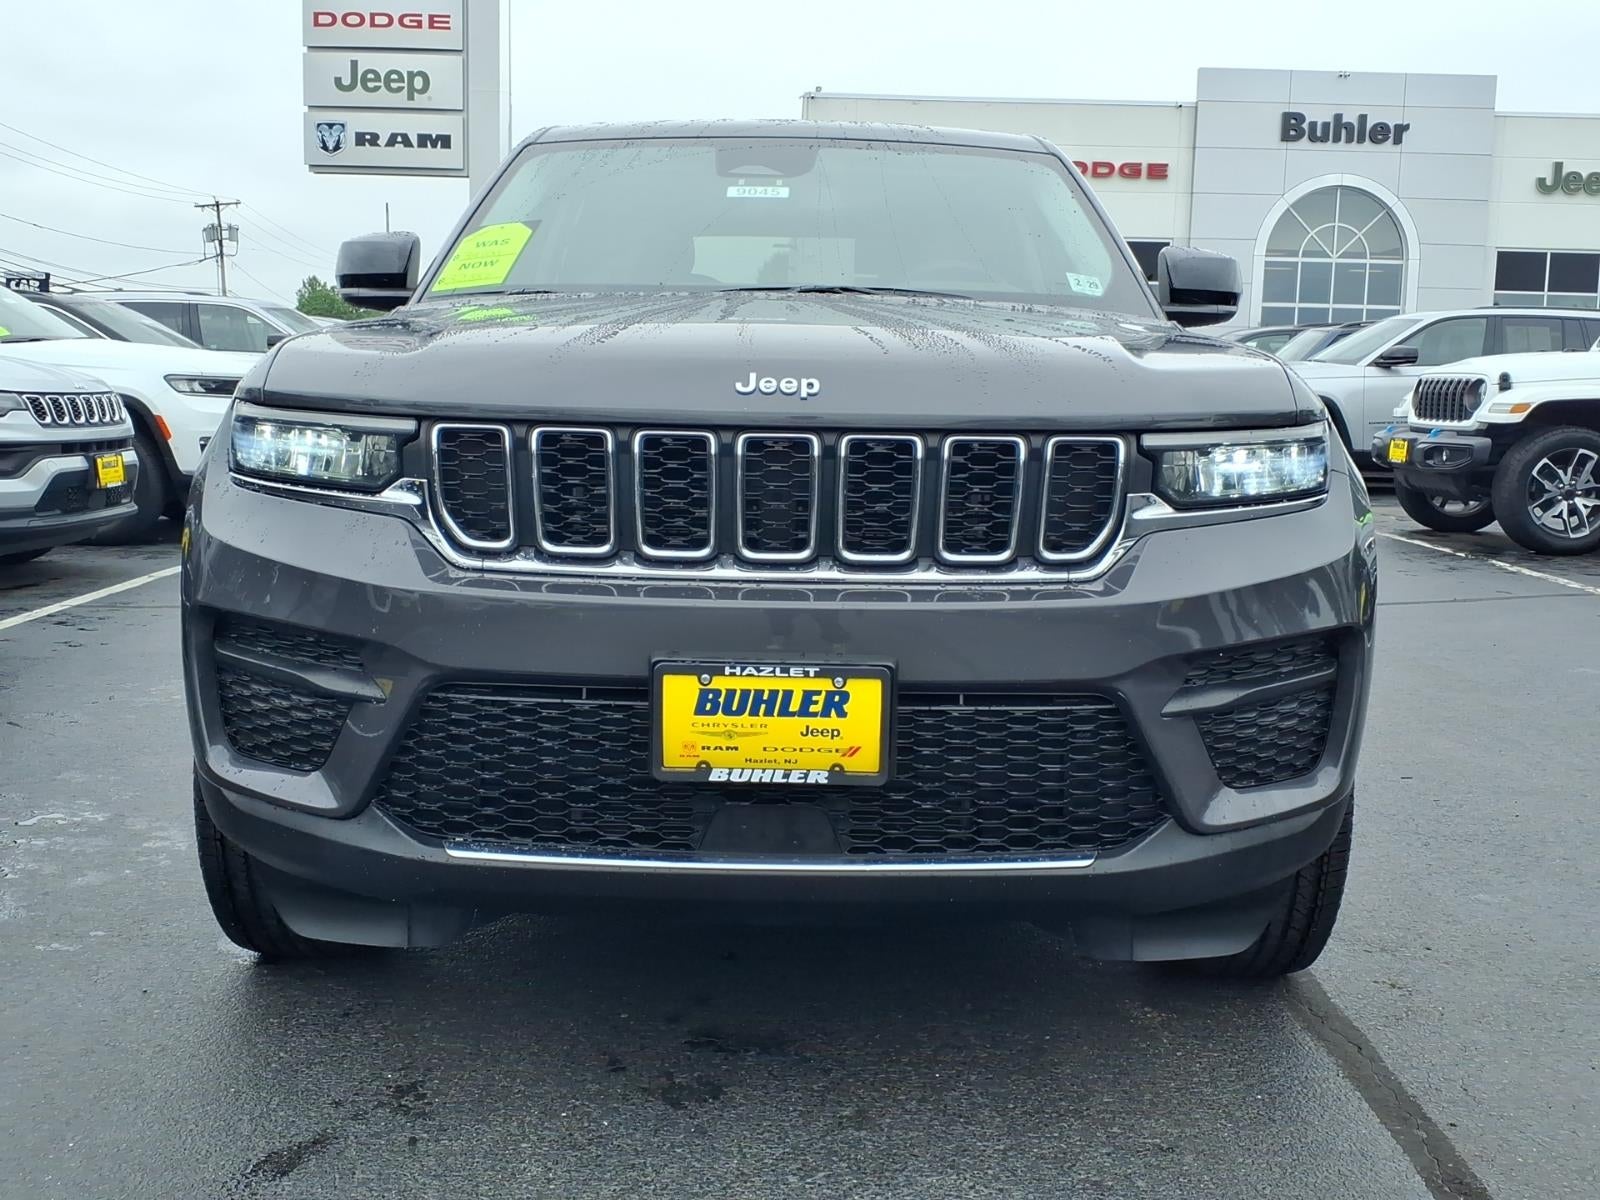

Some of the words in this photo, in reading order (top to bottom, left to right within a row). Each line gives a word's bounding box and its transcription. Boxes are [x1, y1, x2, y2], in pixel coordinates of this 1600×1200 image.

[313, 11, 451, 30] DODGE
[334, 59, 430, 101] Jeep
[1280, 111, 1410, 145] Buhler
[354, 131, 451, 149] RAM
[1072, 160, 1169, 179] DGE
[1536, 161, 1600, 196] Jee
[736, 187, 781, 196] 9045
[475, 238, 511, 249] WAS
[458, 258, 500, 271] NOW
[735, 372, 820, 400] Jeep
[724, 666, 820, 677] HAZLET
[693, 687, 851, 719] BUHLER
[691, 721, 769, 730] CHRYSLER
[800, 725, 841, 740] Jeep
[708, 768, 829, 784] BUHLER
